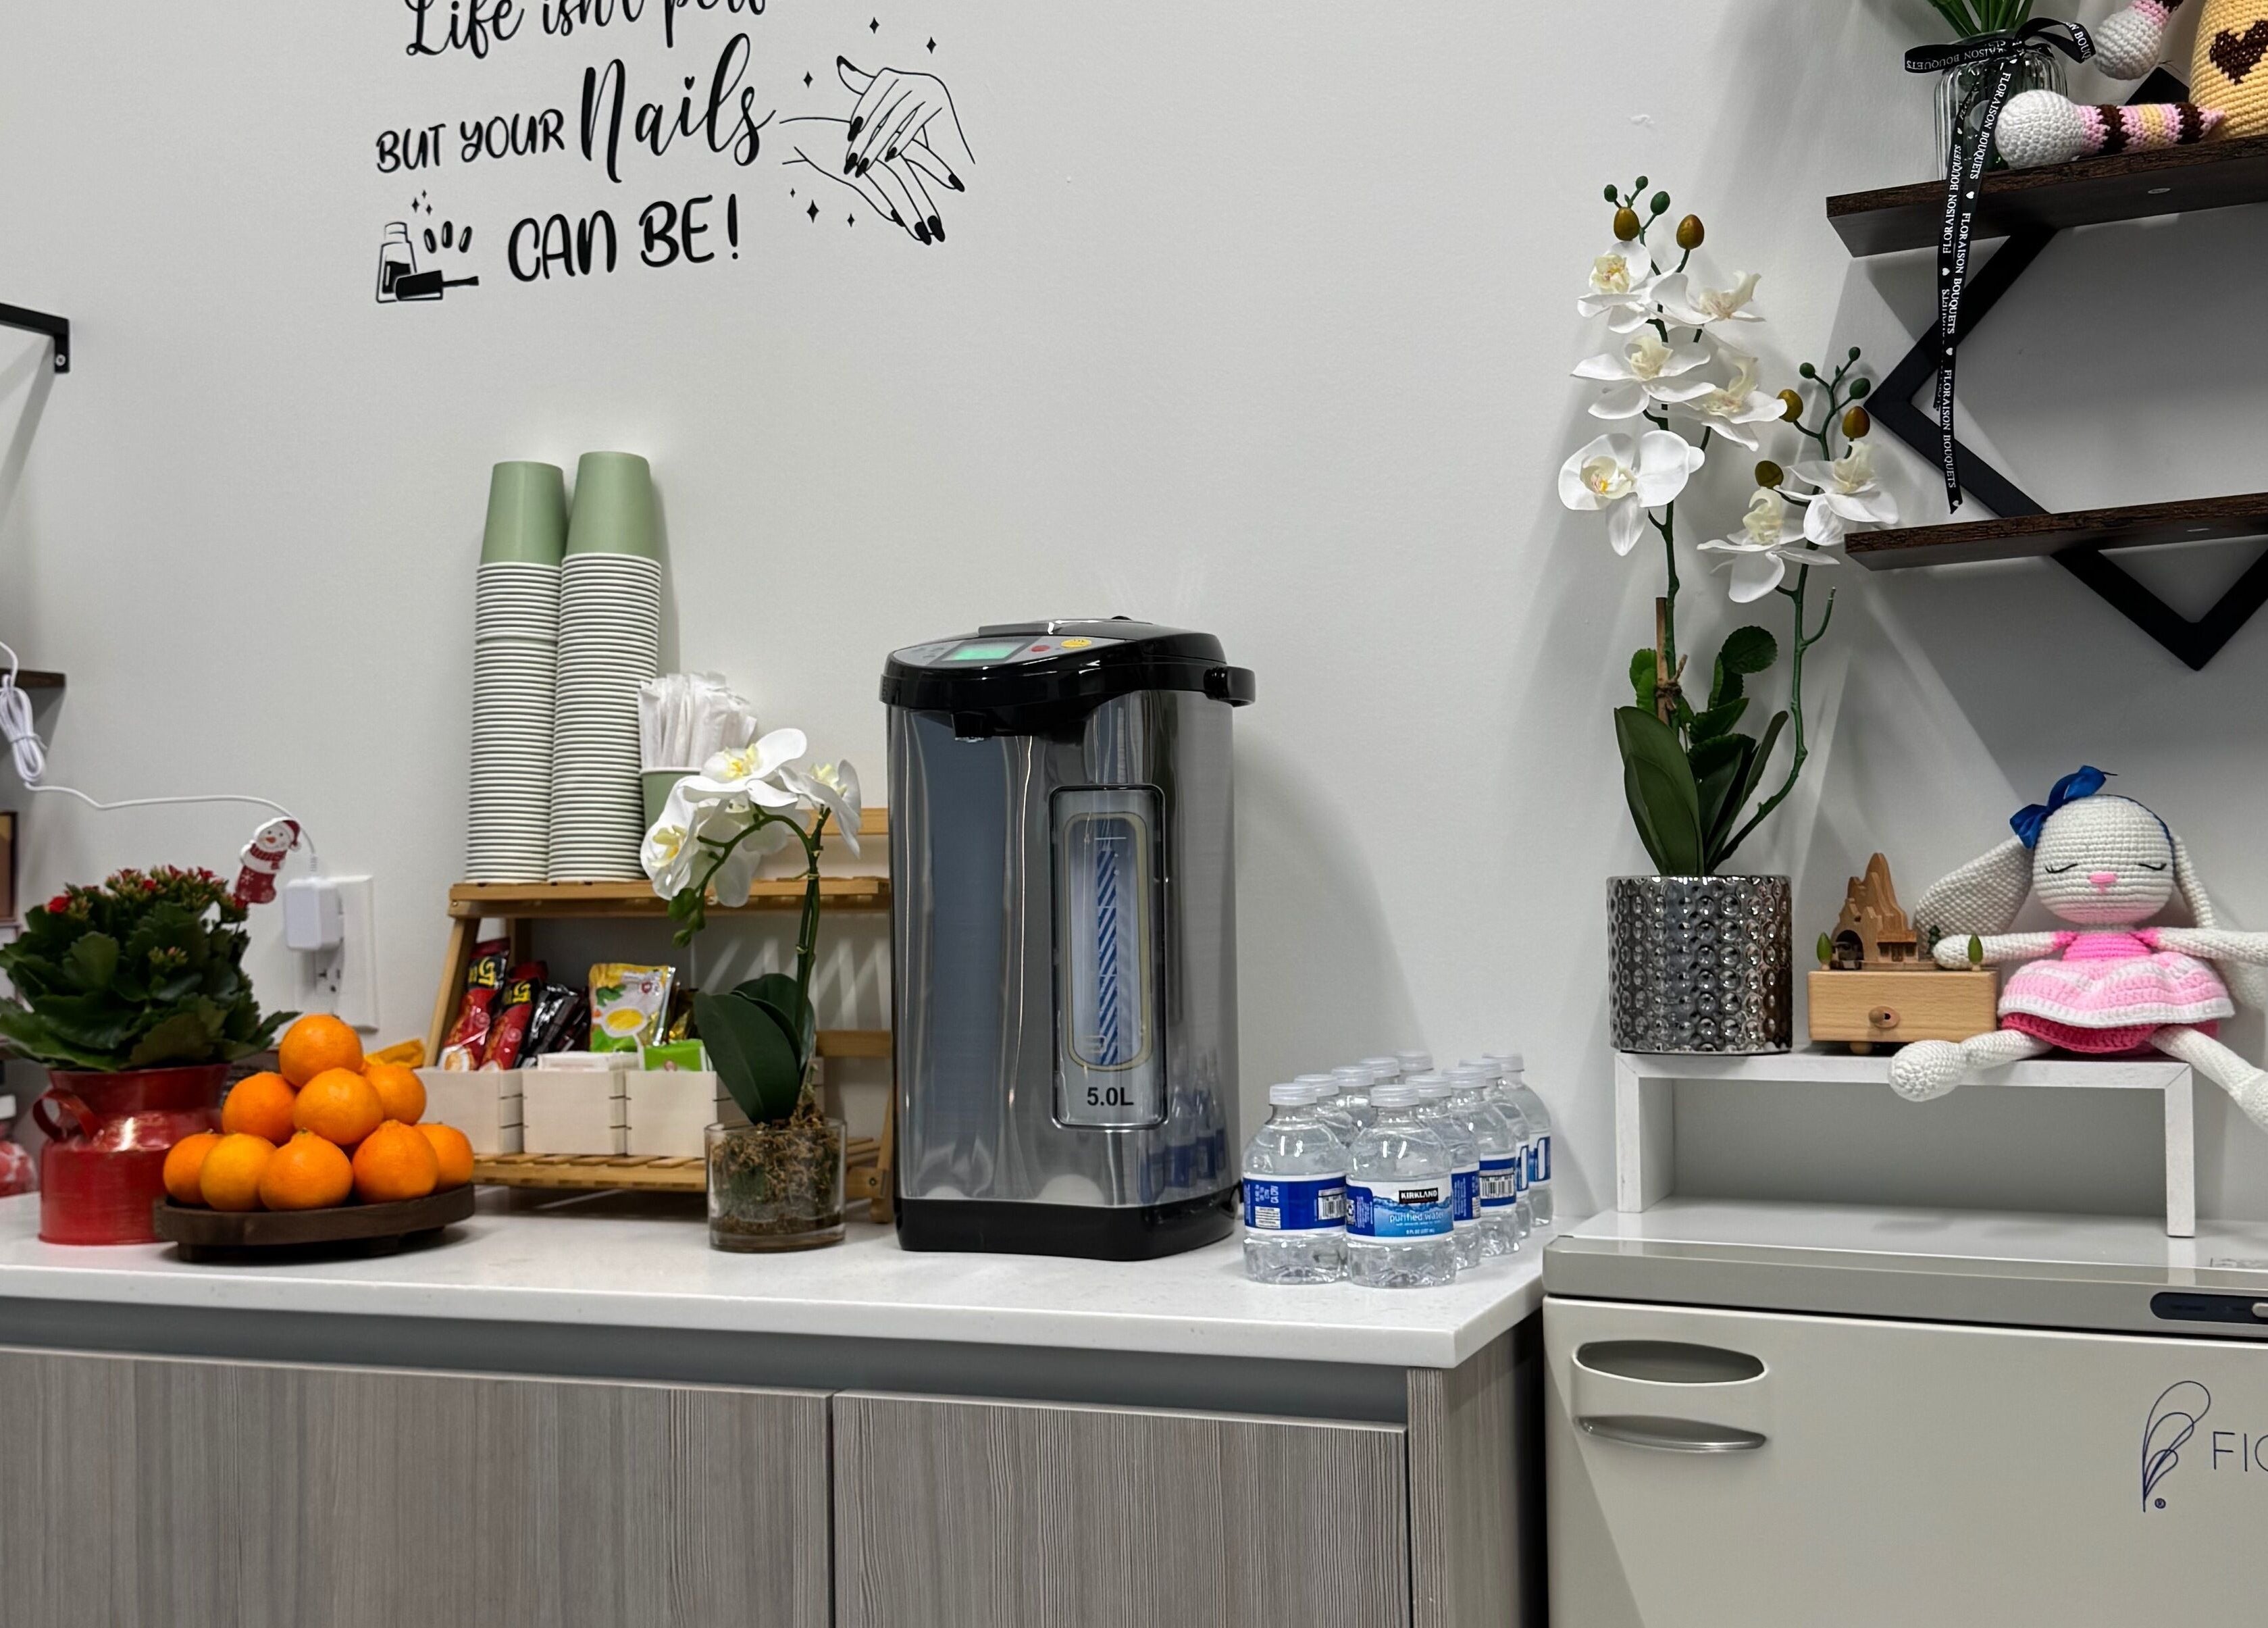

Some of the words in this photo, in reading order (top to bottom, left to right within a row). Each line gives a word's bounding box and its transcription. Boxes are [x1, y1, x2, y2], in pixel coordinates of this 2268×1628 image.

[405, 0, 525, 59] Life
[1907, 55, 1959, 70] BOUQUETS
[376, 124, 446, 173] BUT
[460, 109, 565, 162] YOUR
[581, 33, 776, 183] Nails
[1984, 72, 2011, 130] FLORAISON
[1949, 145, 1963, 191] BOUQUETS
[1969, 132, 1990, 180] BOUQUETS
[508, 210, 617, 282] CAN
[639, 194, 738, 268] BE!
[1942, 194, 1958, 253] FLORAISON
[1955, 213, 1971, 274] FLORAISON
[1947, 278, 1962, 334] BOUQUETS
[1942, 370, 1952, 430] FLORAISON
[1943, 435, 1956, 488] BOUQUETS
[1087, 1087, 1133, 1106] 5.0L
[1390, 1213, 1422, 1223] purified
[1401, 1190, 1437, 1199] KIRKLAND
